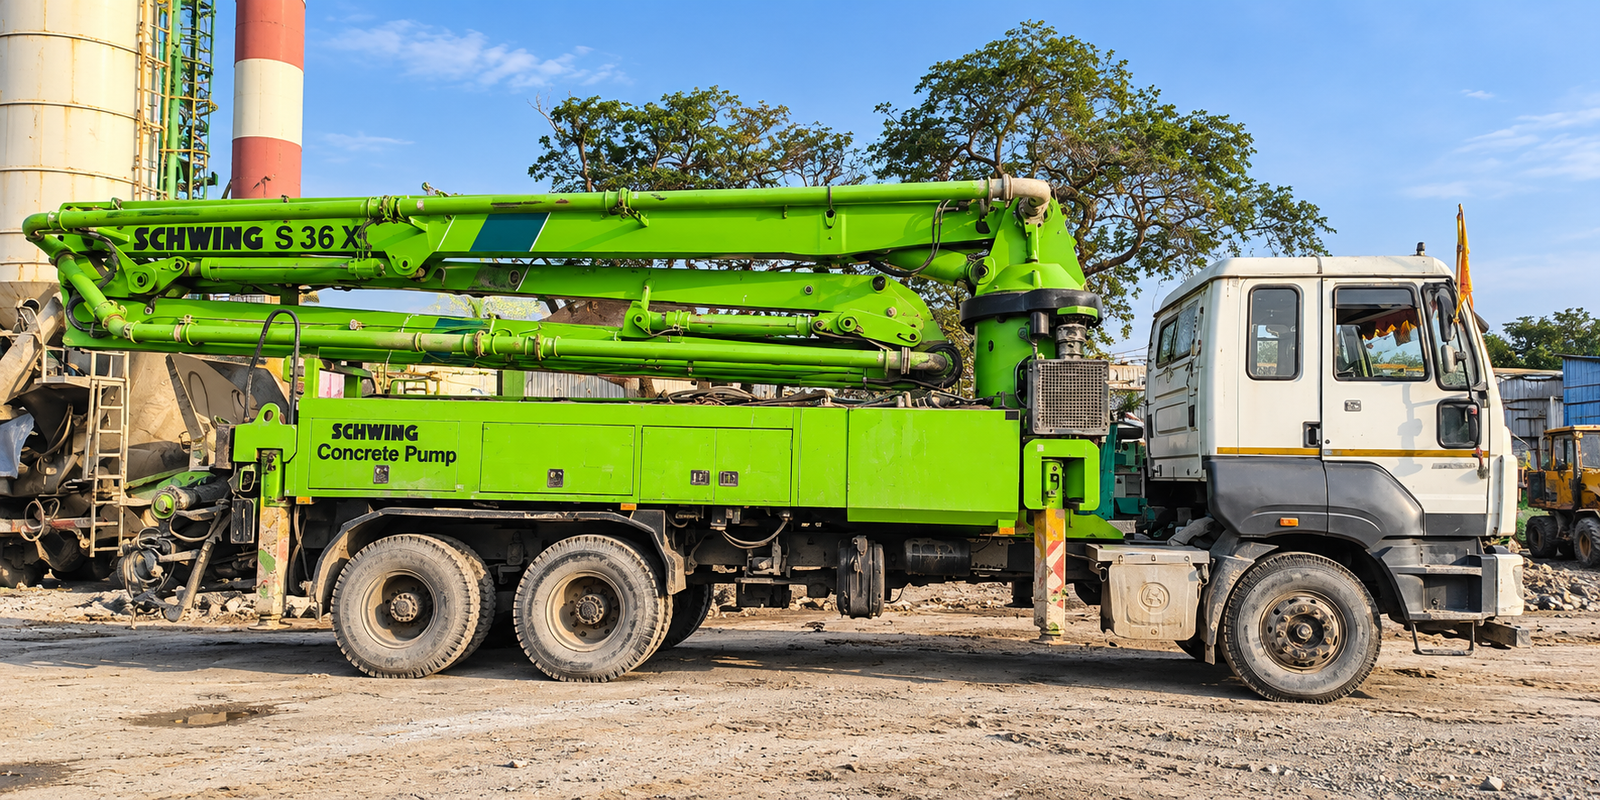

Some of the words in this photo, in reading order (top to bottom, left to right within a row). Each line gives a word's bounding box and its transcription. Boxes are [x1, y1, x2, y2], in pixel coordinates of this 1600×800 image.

[133, 226, 263, 251] SCHWING
[275, 225, 293, 249] S
[300, 225, 334, 249] 36
[341, 225, 362, 249] X
[331, 423, 418, 441] SCHWING
[317, 443, 399, 462] Concrete
[405, 445, 457, 467] Pump
